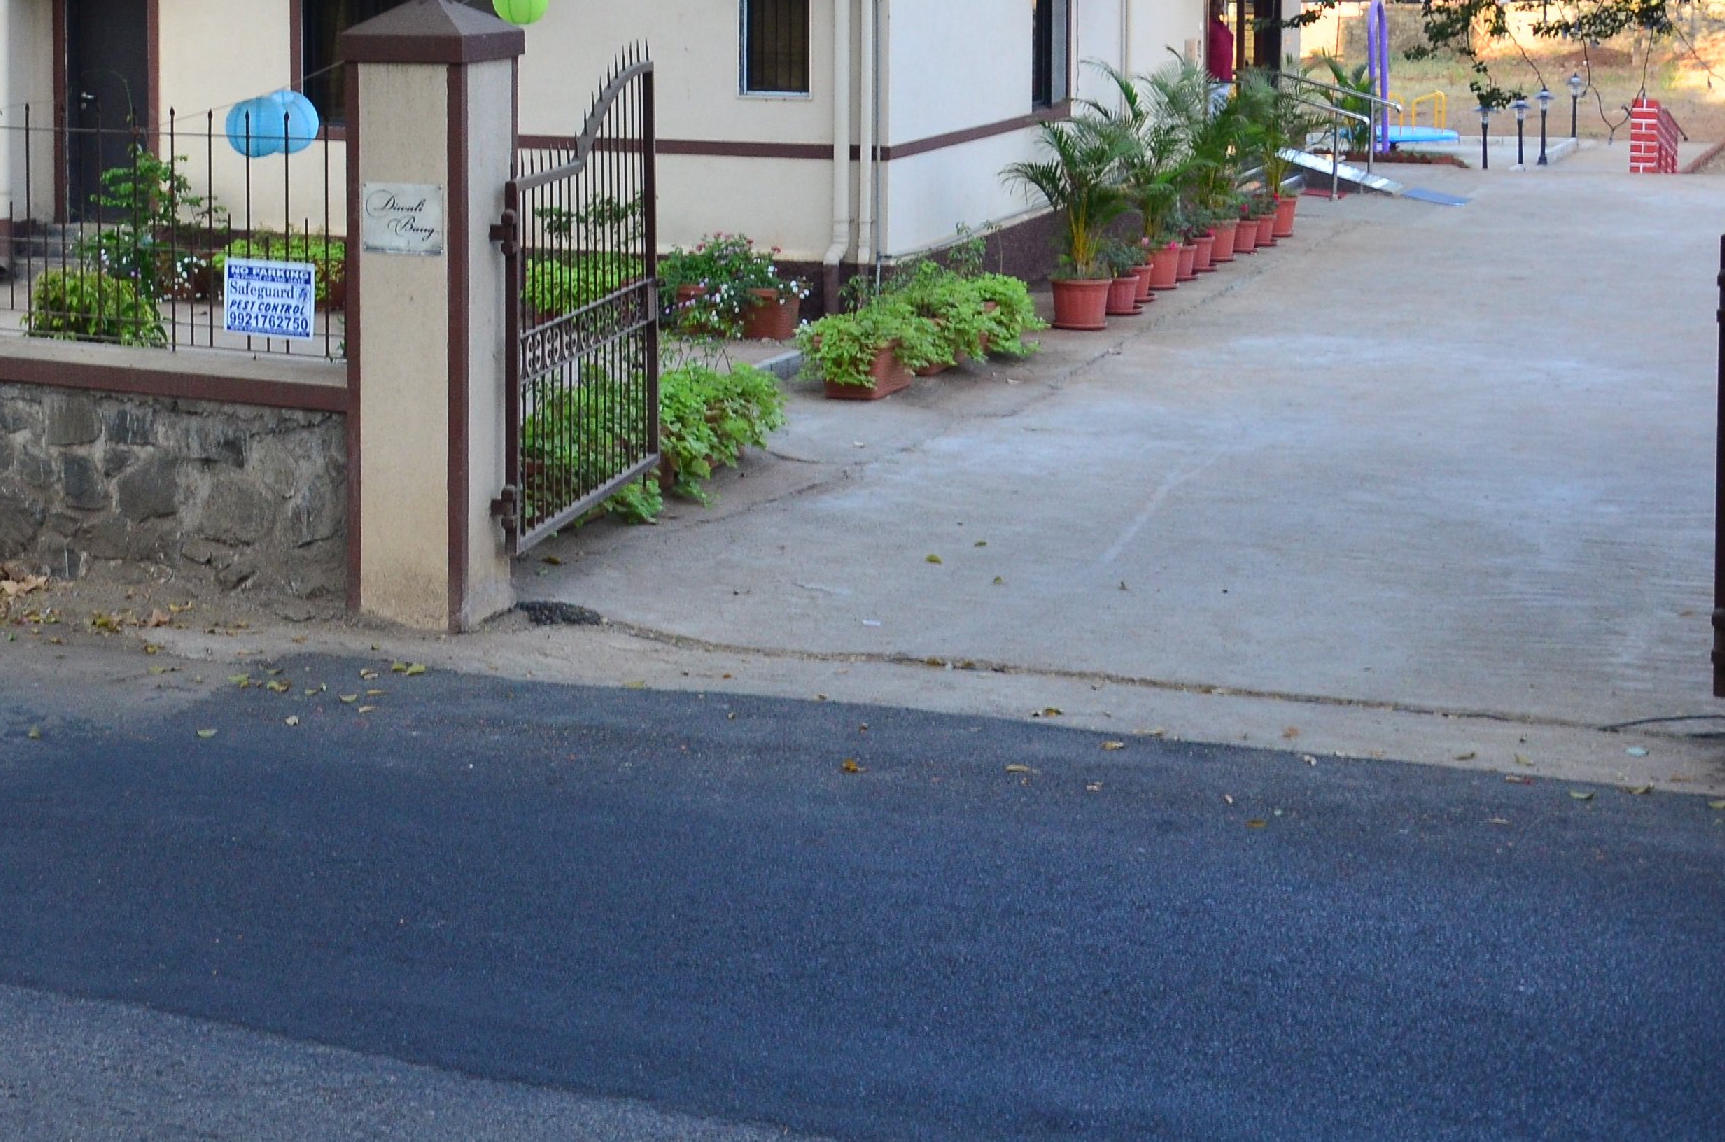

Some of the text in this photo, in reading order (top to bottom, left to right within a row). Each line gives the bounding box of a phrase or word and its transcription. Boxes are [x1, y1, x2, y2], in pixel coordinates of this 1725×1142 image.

[230, 265, 249, 275] NO
[252, 266, 309, 279] PARKING
[230, 280, 294, 299] Safeguard
[229, 299, 305, 315] PEST CONTROL
